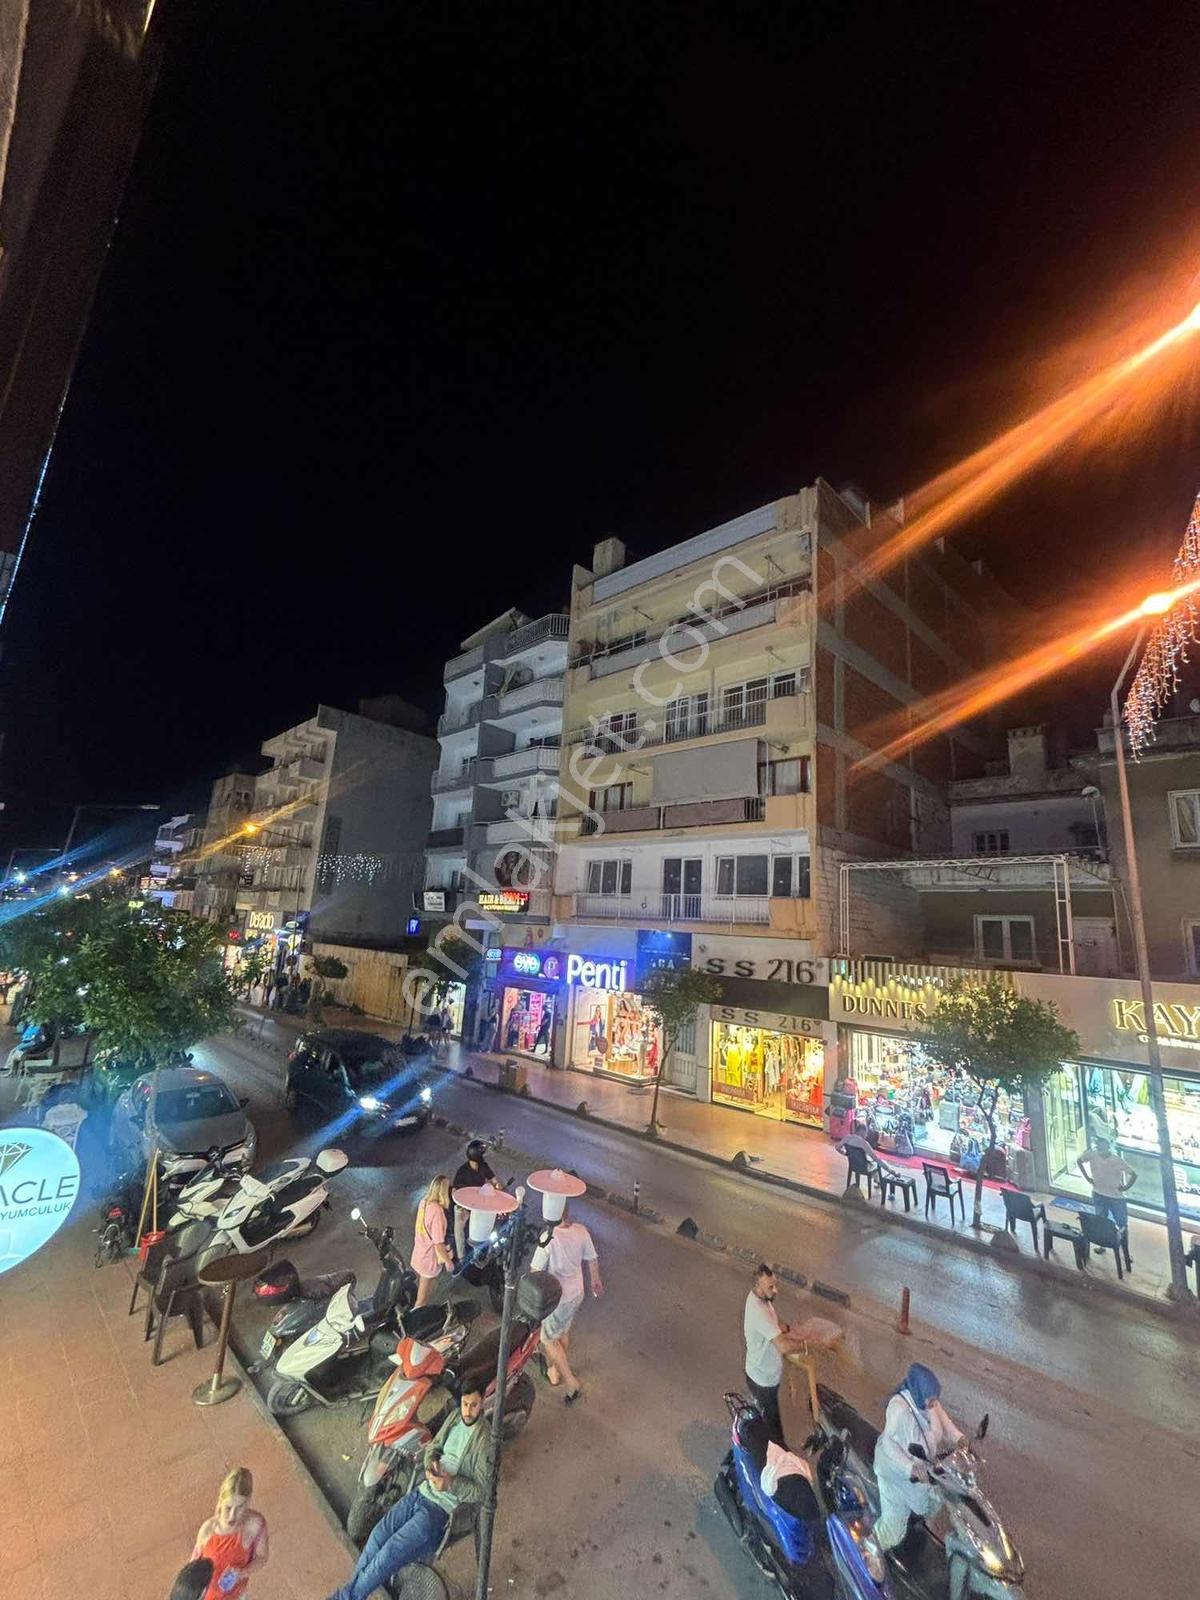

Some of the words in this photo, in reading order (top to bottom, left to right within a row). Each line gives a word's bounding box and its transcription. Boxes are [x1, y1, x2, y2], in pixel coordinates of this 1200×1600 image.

[566, 954, 627, 992] Penti
[767, 958, 814, 984] 216
[842, 993, 928, 1020] DUNNES
[1112, 998, 1200, 1038] KAY
[778, 1015, 812, 1032] 216
